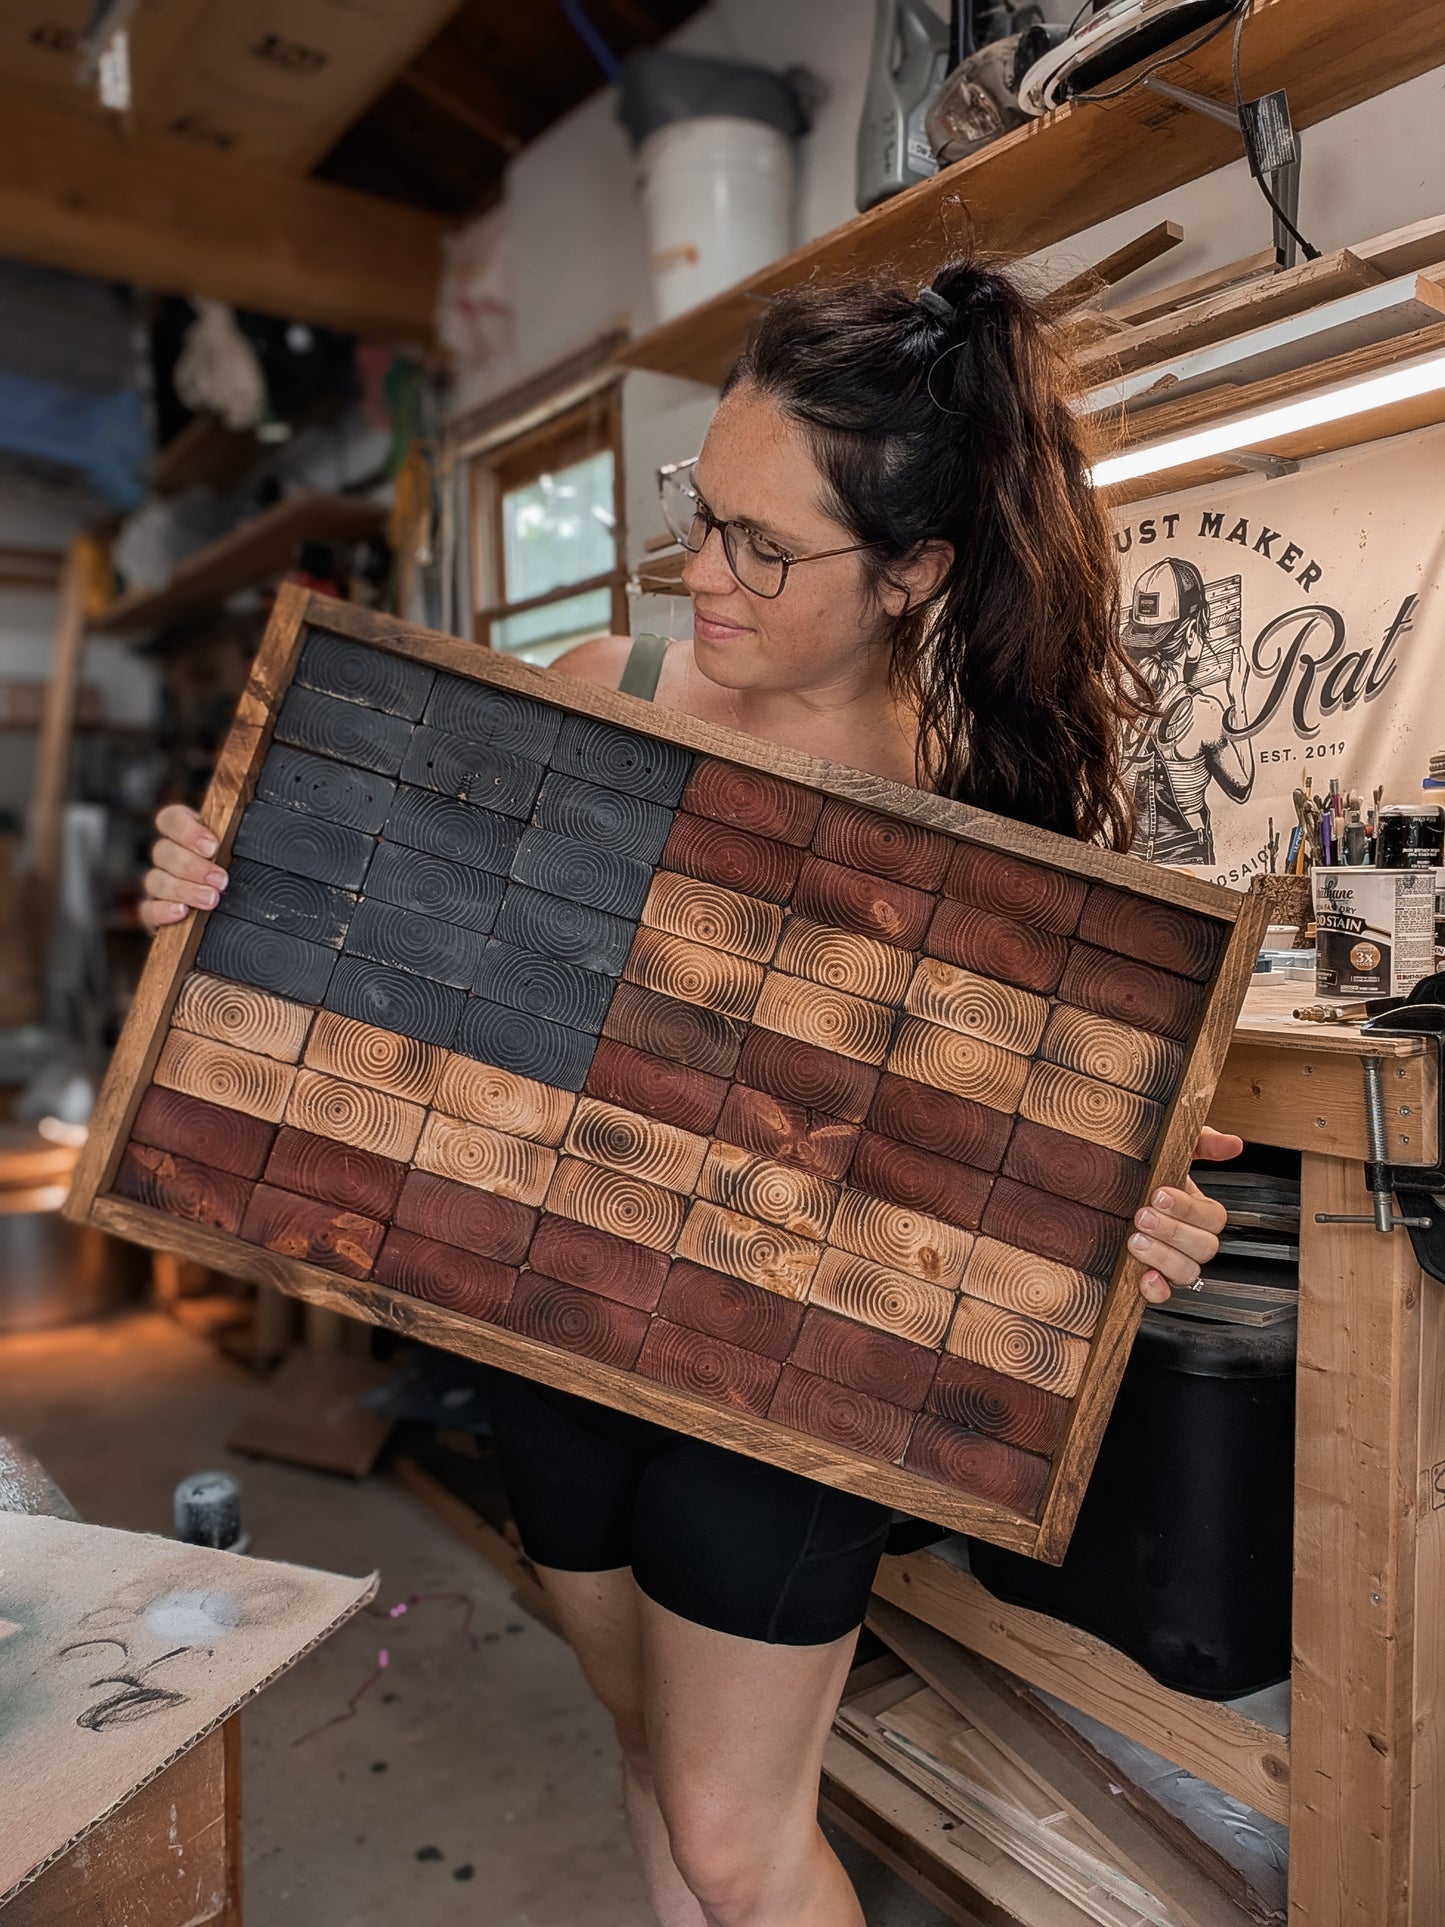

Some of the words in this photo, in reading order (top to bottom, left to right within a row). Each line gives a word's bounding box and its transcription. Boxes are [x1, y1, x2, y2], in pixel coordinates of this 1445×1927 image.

[1113, 513, 1180, 554] UST
[1198, 511, 1323, 593] MAKER
[1221, 592, 1420, 739] Rat
[1260, 748, 1297, 763] EST.
[1305, 741, 1345, 759] 2019
[1209, 849, 1269, 887] OSAIC
[1319, 880, 1355, 899] thane
[1340, 905, 1357, 915] DRY
[1327, 916, 1362, 932] STAIN
